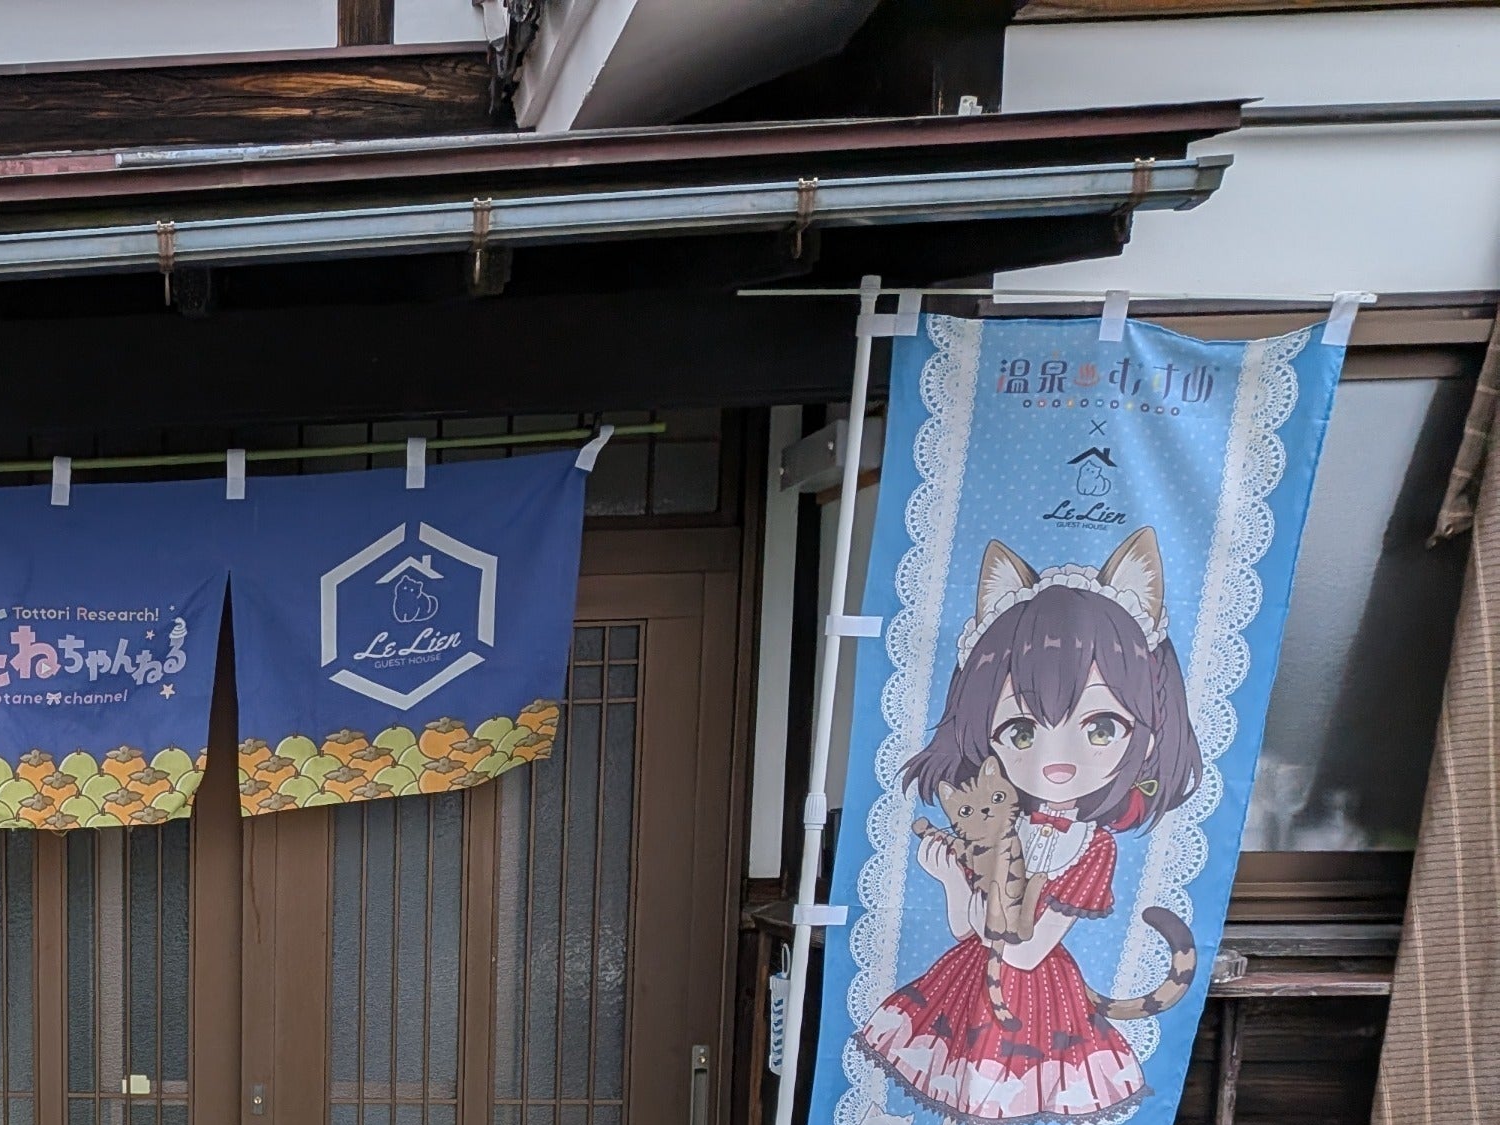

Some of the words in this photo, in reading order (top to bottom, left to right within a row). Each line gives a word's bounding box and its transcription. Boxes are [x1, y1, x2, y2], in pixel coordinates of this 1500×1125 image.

[1076, 502, 1126, 525] Lien
[11, 606, 70, 621] Tottori
[76, 606, 160, 622] Research!
[353, 632, 397, 660] Le
[398, 627, 462, 655] Lien
[374, 657, 406, 669] GUEST
[408, 653, 442, 664] HOUSE
[64, 688, 128, 705] channel
